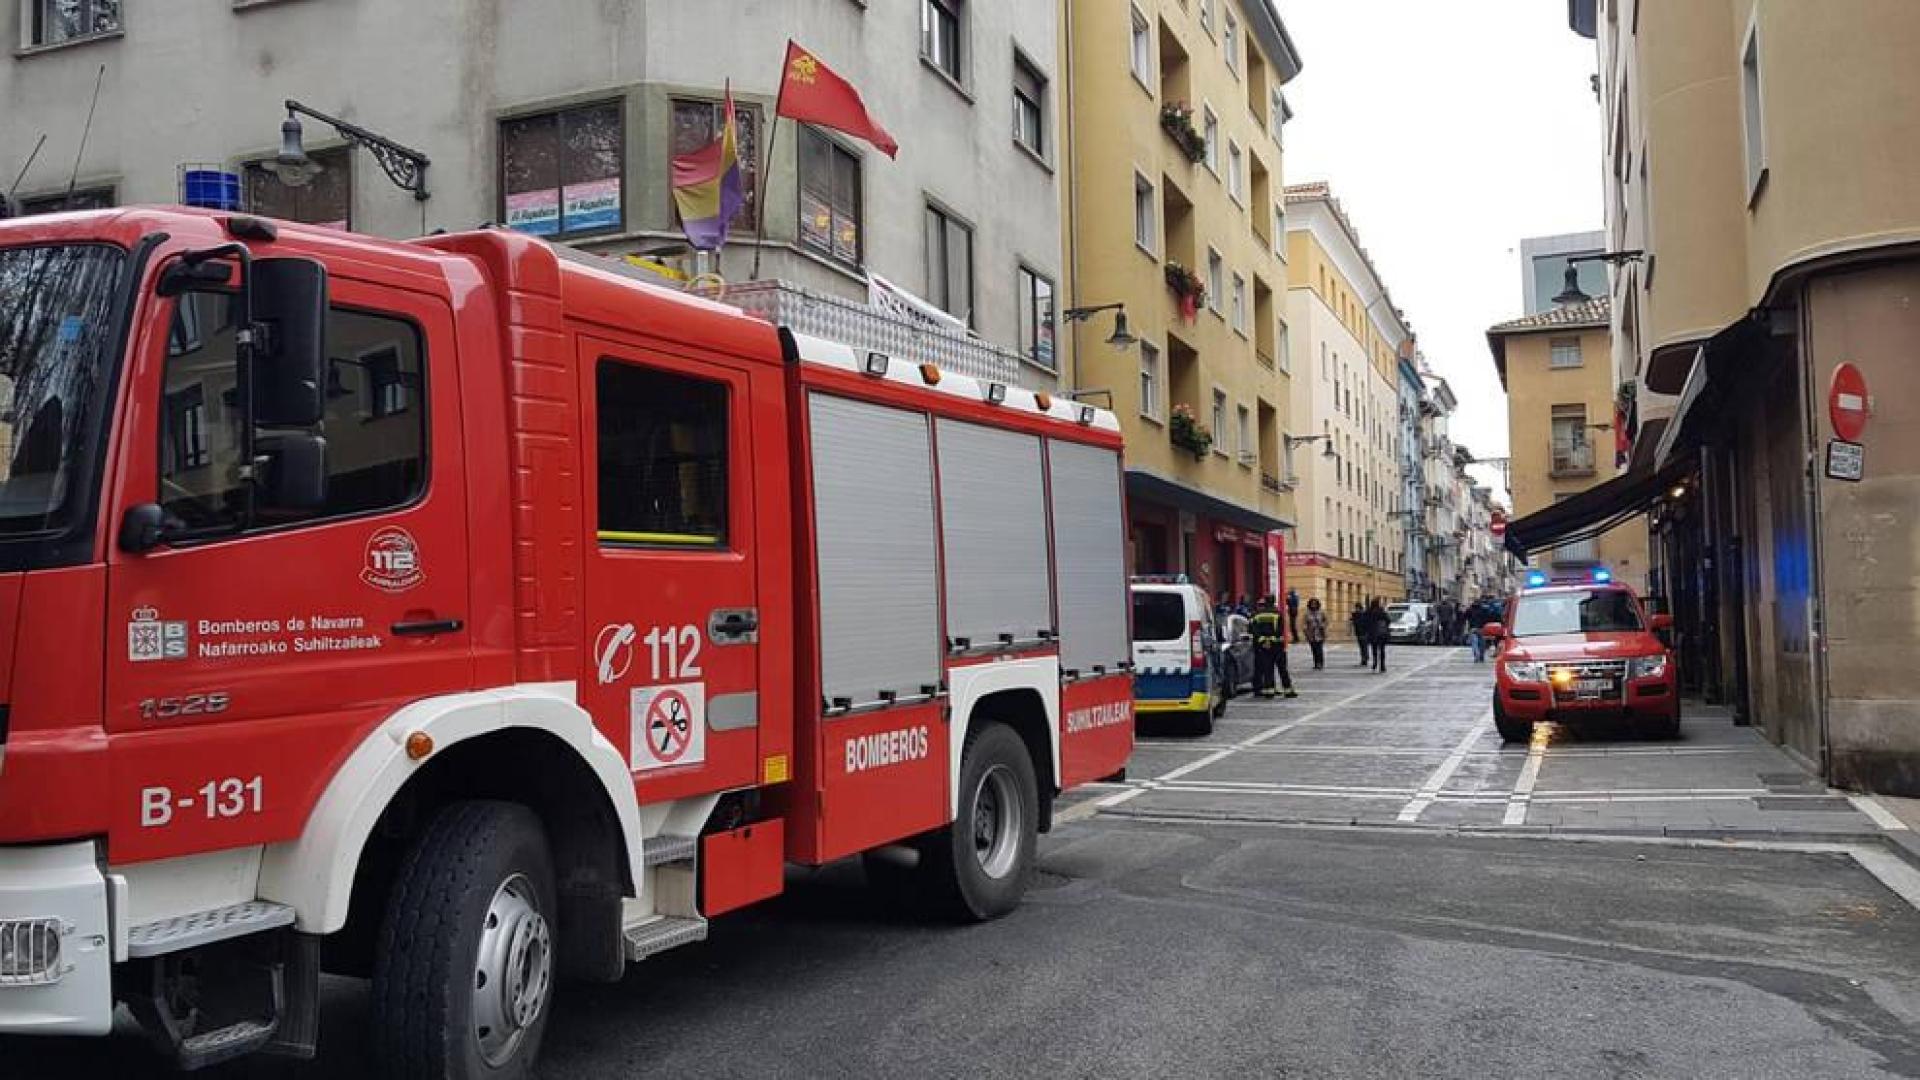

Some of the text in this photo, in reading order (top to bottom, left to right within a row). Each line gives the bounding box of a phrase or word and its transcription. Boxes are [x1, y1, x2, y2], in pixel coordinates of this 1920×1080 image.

[371, 549, 415, 569] 112
[164, 622, 185, 638] B
[198, 615, 364, 635] Bomberos de Navarra
[165, 640, 185, 656] S
[199, 635, 382, 657] Nafarroako Suhiltzaileak
[643, 623, 702, 680] 112
[845, 724, 929, 774] BOMBEROS
[141, 775, 264, 827] B-131
